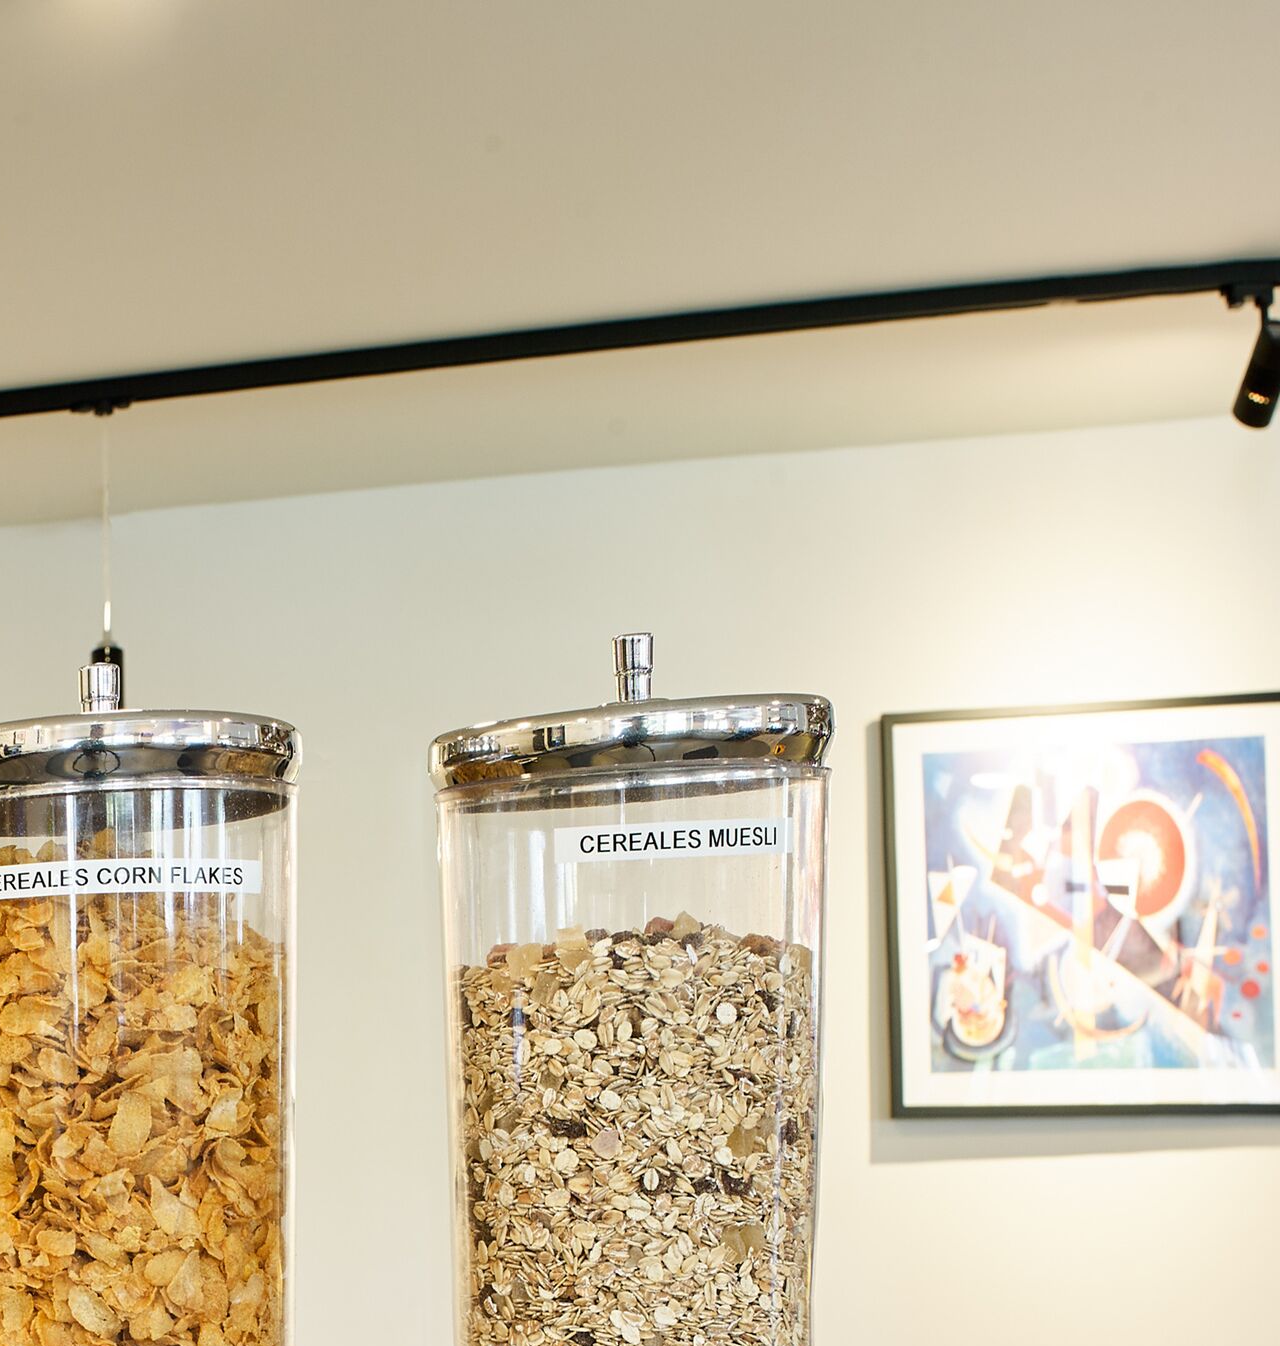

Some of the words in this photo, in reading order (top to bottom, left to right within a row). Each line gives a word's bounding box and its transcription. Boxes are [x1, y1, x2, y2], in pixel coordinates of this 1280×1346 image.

[579, 829, 702, 854] CEREALES
[708, 826, 778, 848] MUESLI
[96, 866, 162, 886] CORN
[170, 866, 244, 886] FLAKES
